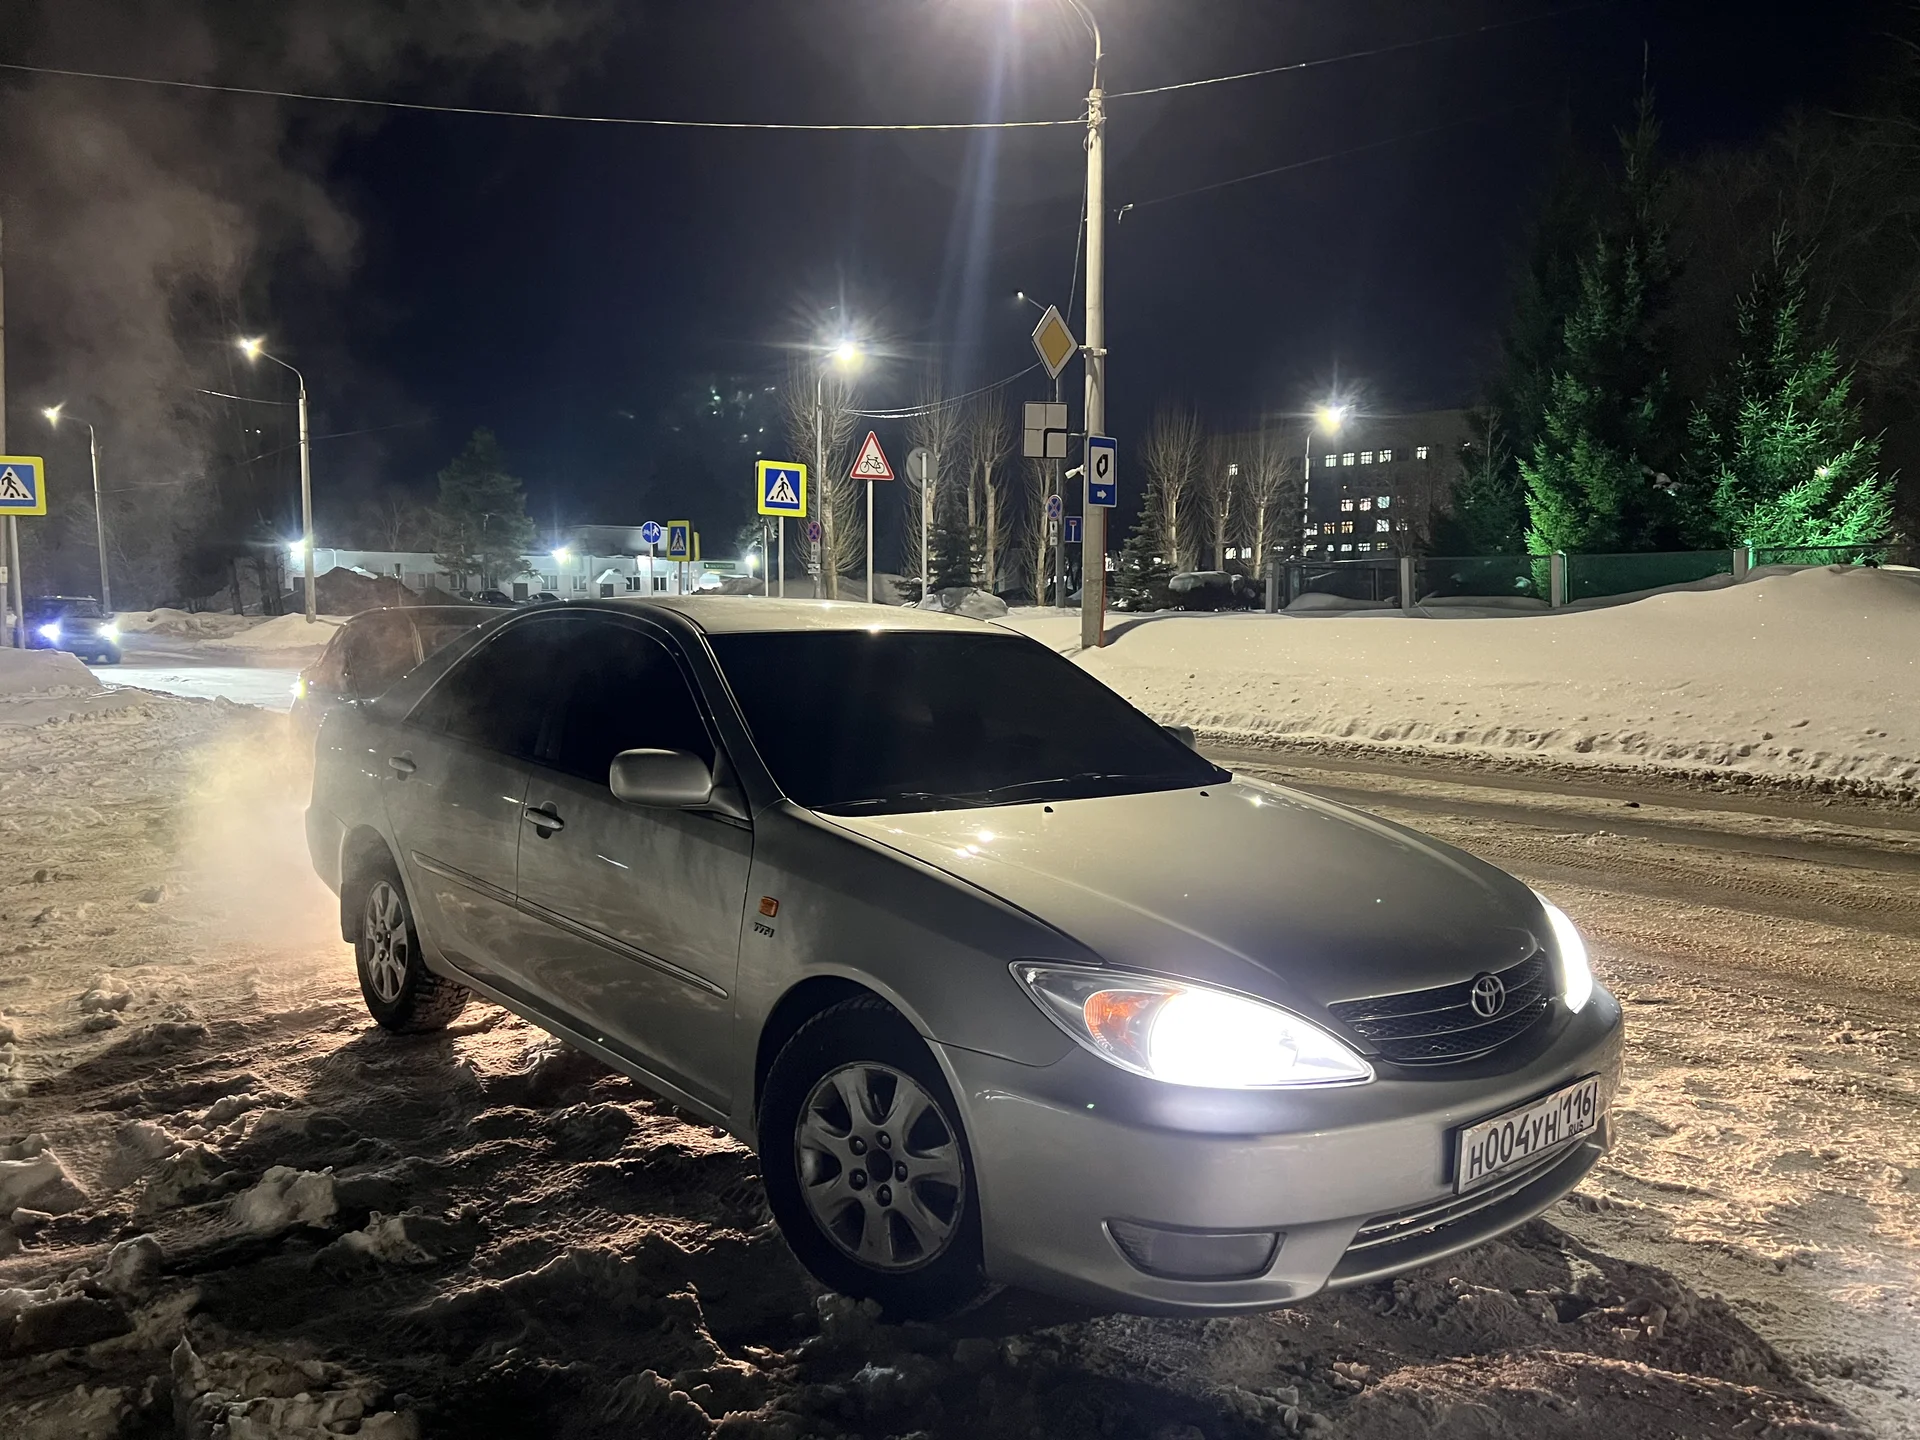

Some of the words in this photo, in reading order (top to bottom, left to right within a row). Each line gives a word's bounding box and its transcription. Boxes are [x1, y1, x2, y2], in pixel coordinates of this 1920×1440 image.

[1469, 1110, 1558, 1179] Н004УН
[1563, 1085, 1591, 1124] 116
[1568, 1119, 1584, 1137] RUS
